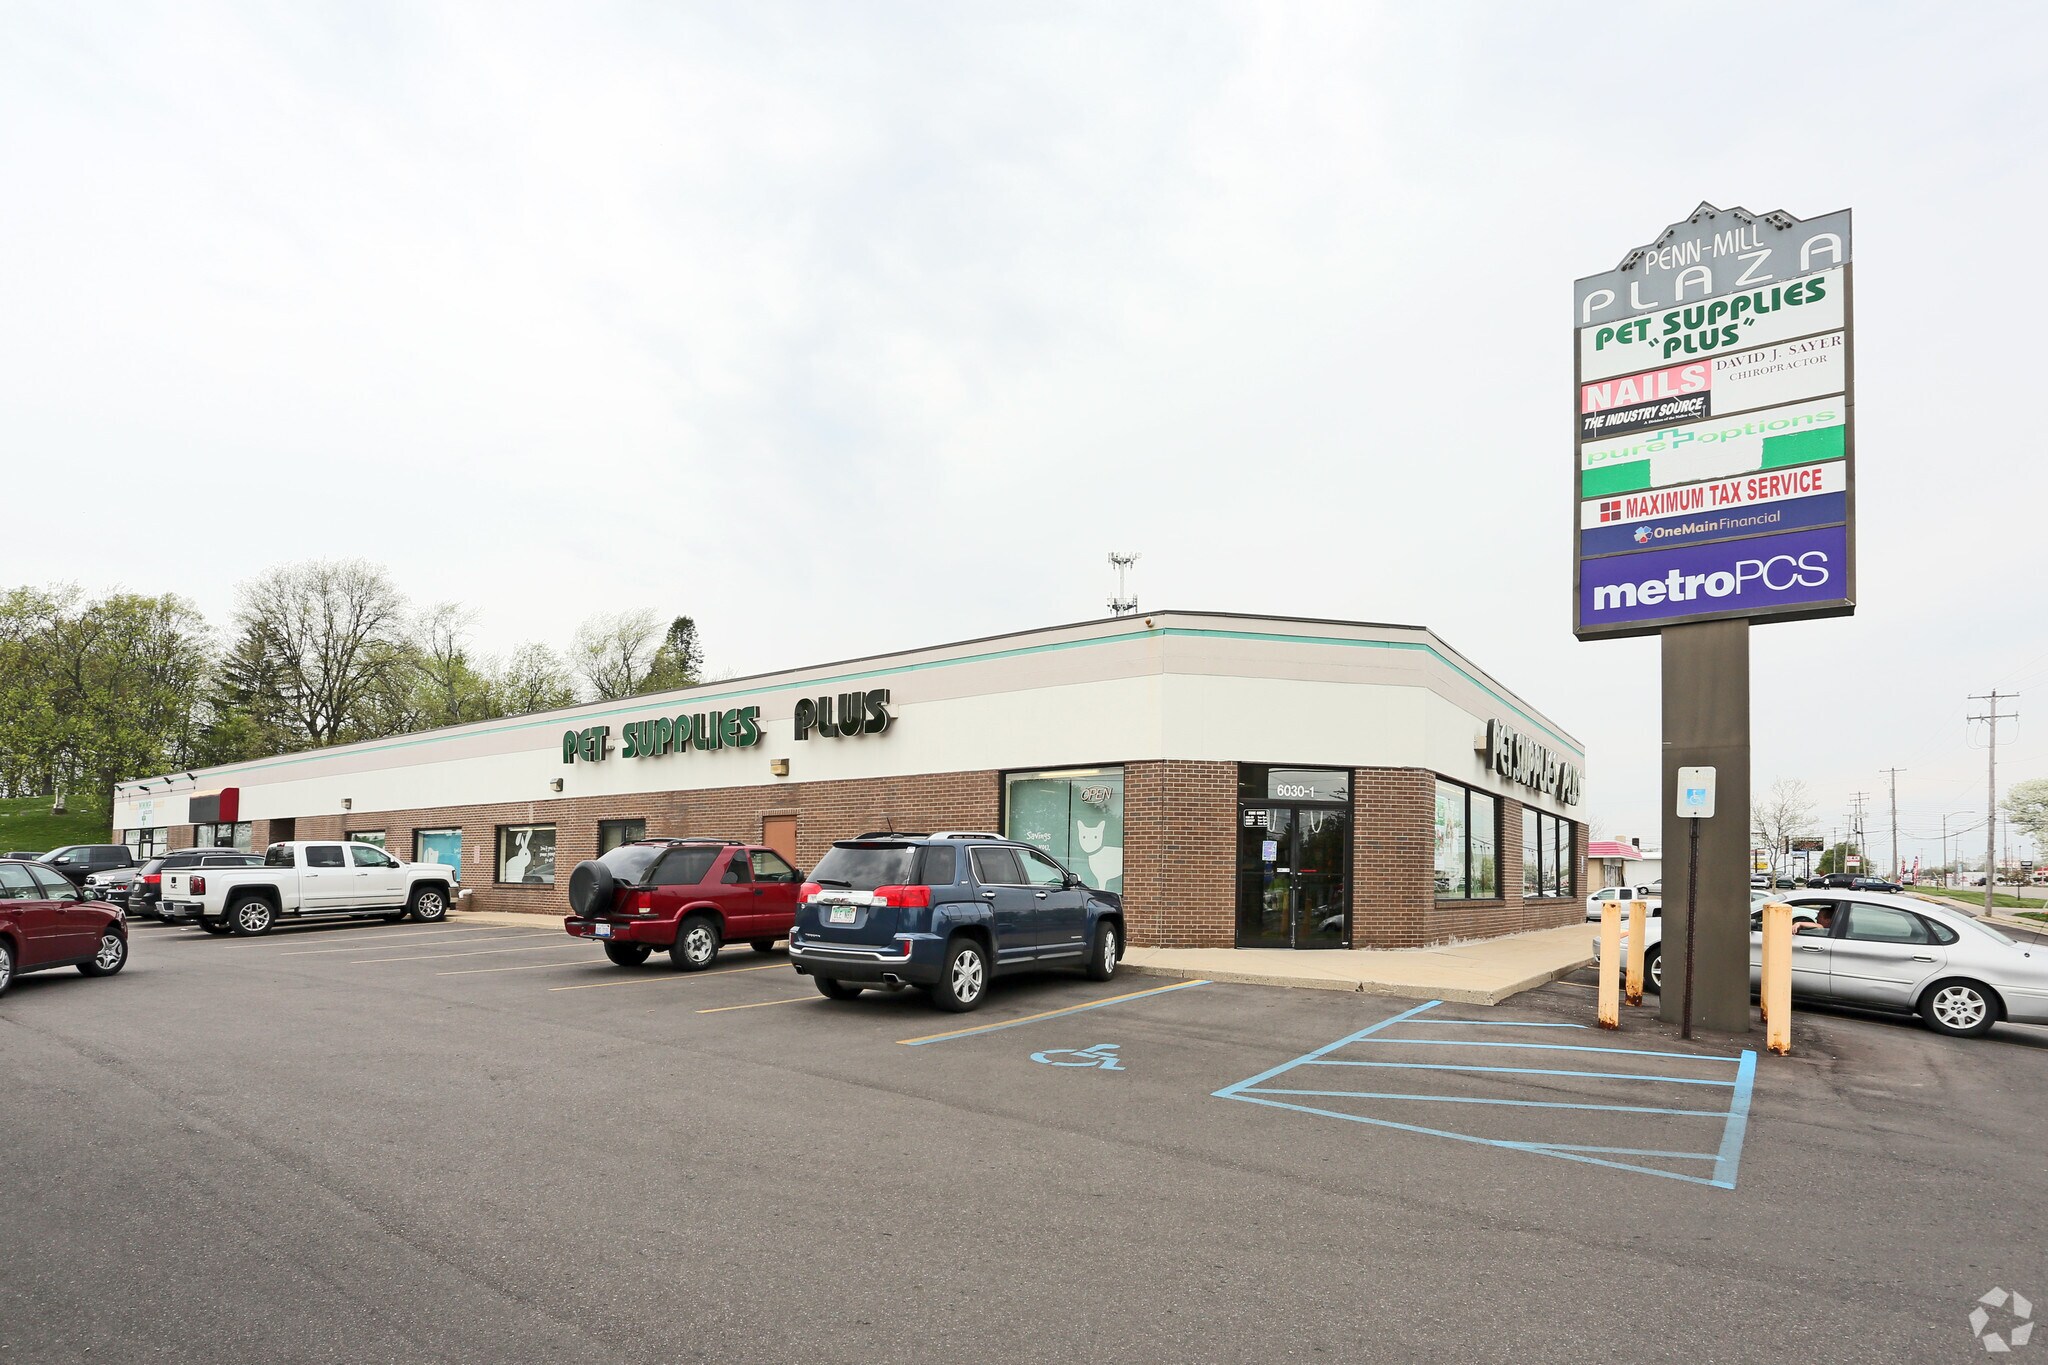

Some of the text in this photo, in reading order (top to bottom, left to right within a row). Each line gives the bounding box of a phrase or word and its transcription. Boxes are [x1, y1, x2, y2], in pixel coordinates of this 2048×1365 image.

[1645, 224, 1765, 275] PENN-MILL
[1582, 232, 1843, 324] PLAZA
[1595, 276, 1827, 352] PET SUPPLIES
[1715, 335, 1843, 372] DAVID J. SAYER
[1729, 354, 1828, 382] CHIROPRACTOR
[1584, 396, 1705, 430] THE INDUSTRY SOURCE
[1585, 364, 1707, 412] NAILS
[1586, 409, 1837, 465] pure options
[1626, 468, 1823, 519] MAXIMUM TAX SERVICE
[1593, 551, 1830, 611] metroPCS
[563, 688, 891, 764] PET SUPPLIES PLUS
[1486, 718, 1514, 779] PET
[1513, 733, 1559, 797] SUPPLIES
[1081, 788, 1113, 801] OPEN
[1277, 784, 1315, 798] 6030-1
[1026, 830, 1052, 842] Savings
